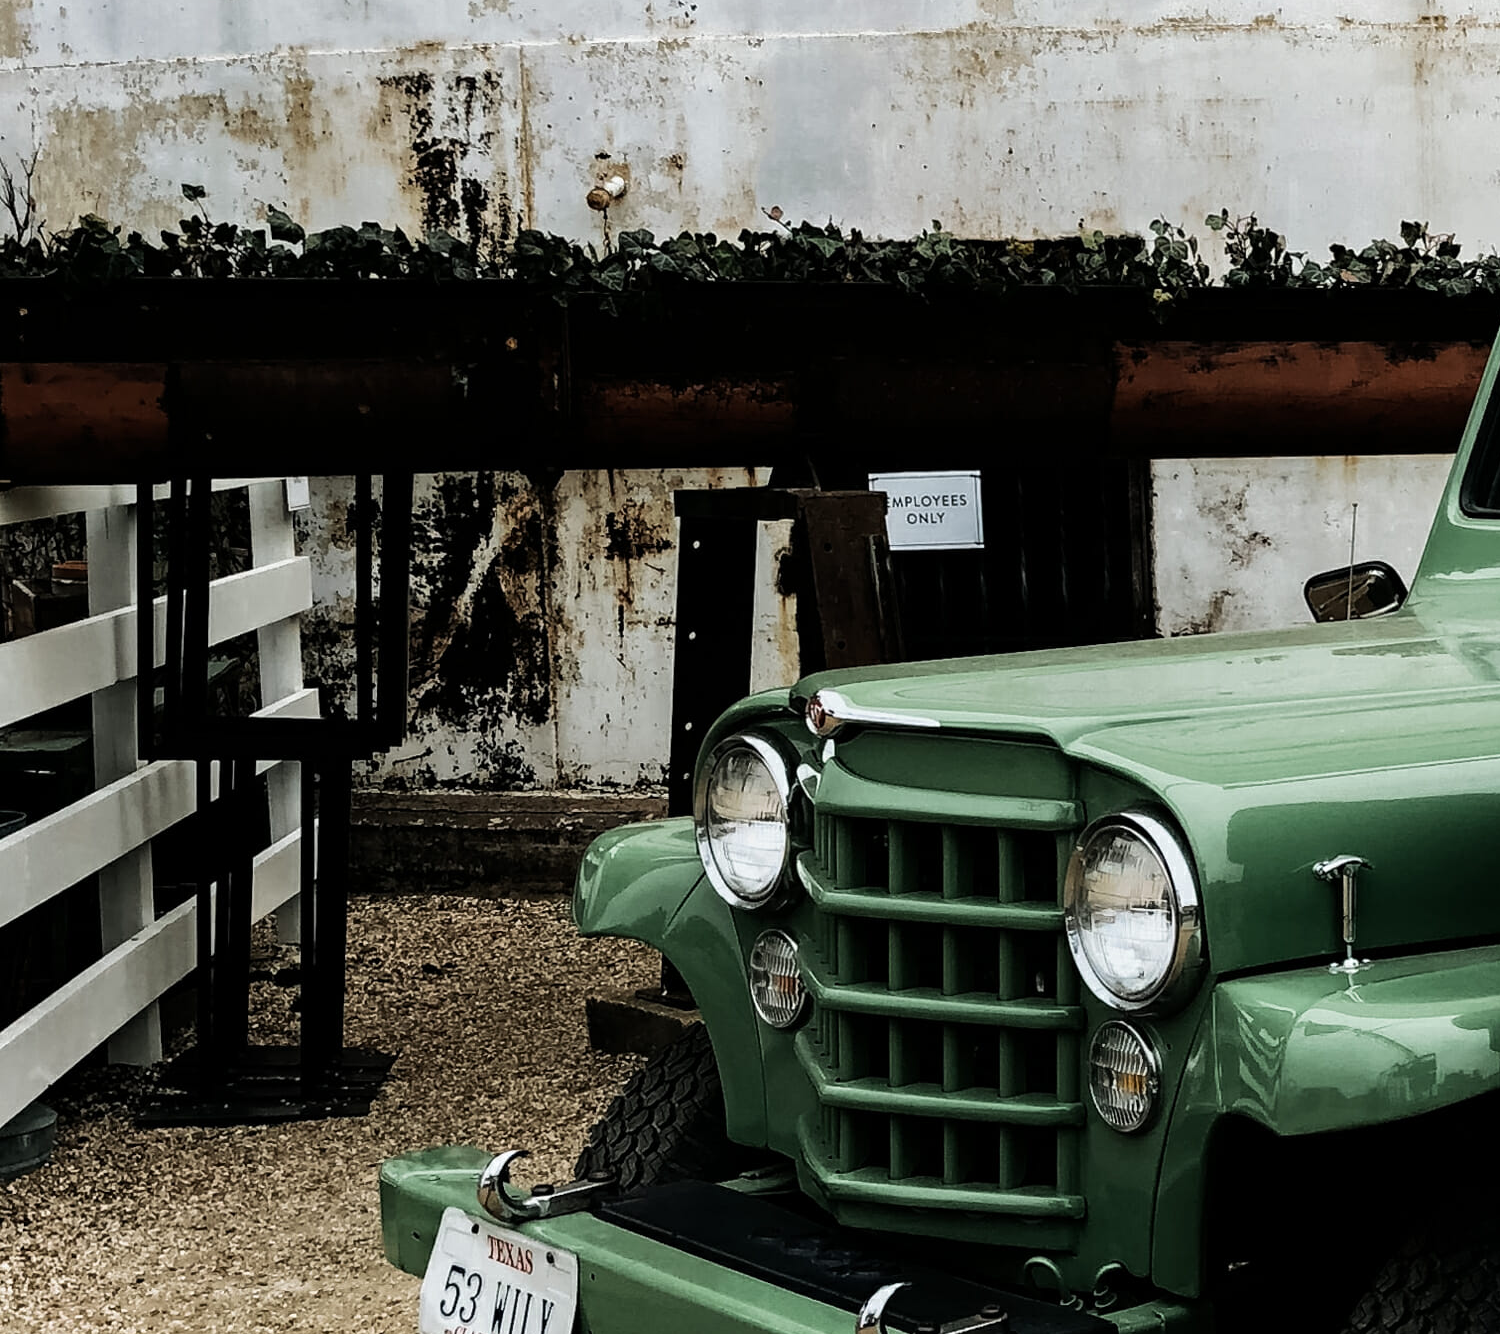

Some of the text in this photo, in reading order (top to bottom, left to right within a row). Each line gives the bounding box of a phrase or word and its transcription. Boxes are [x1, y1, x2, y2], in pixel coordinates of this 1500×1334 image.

[906, 512, 946, 525] ONLY
[487, 1235, 534, 1275] TEXAS
[440, 1265, 483, 1323] 53
